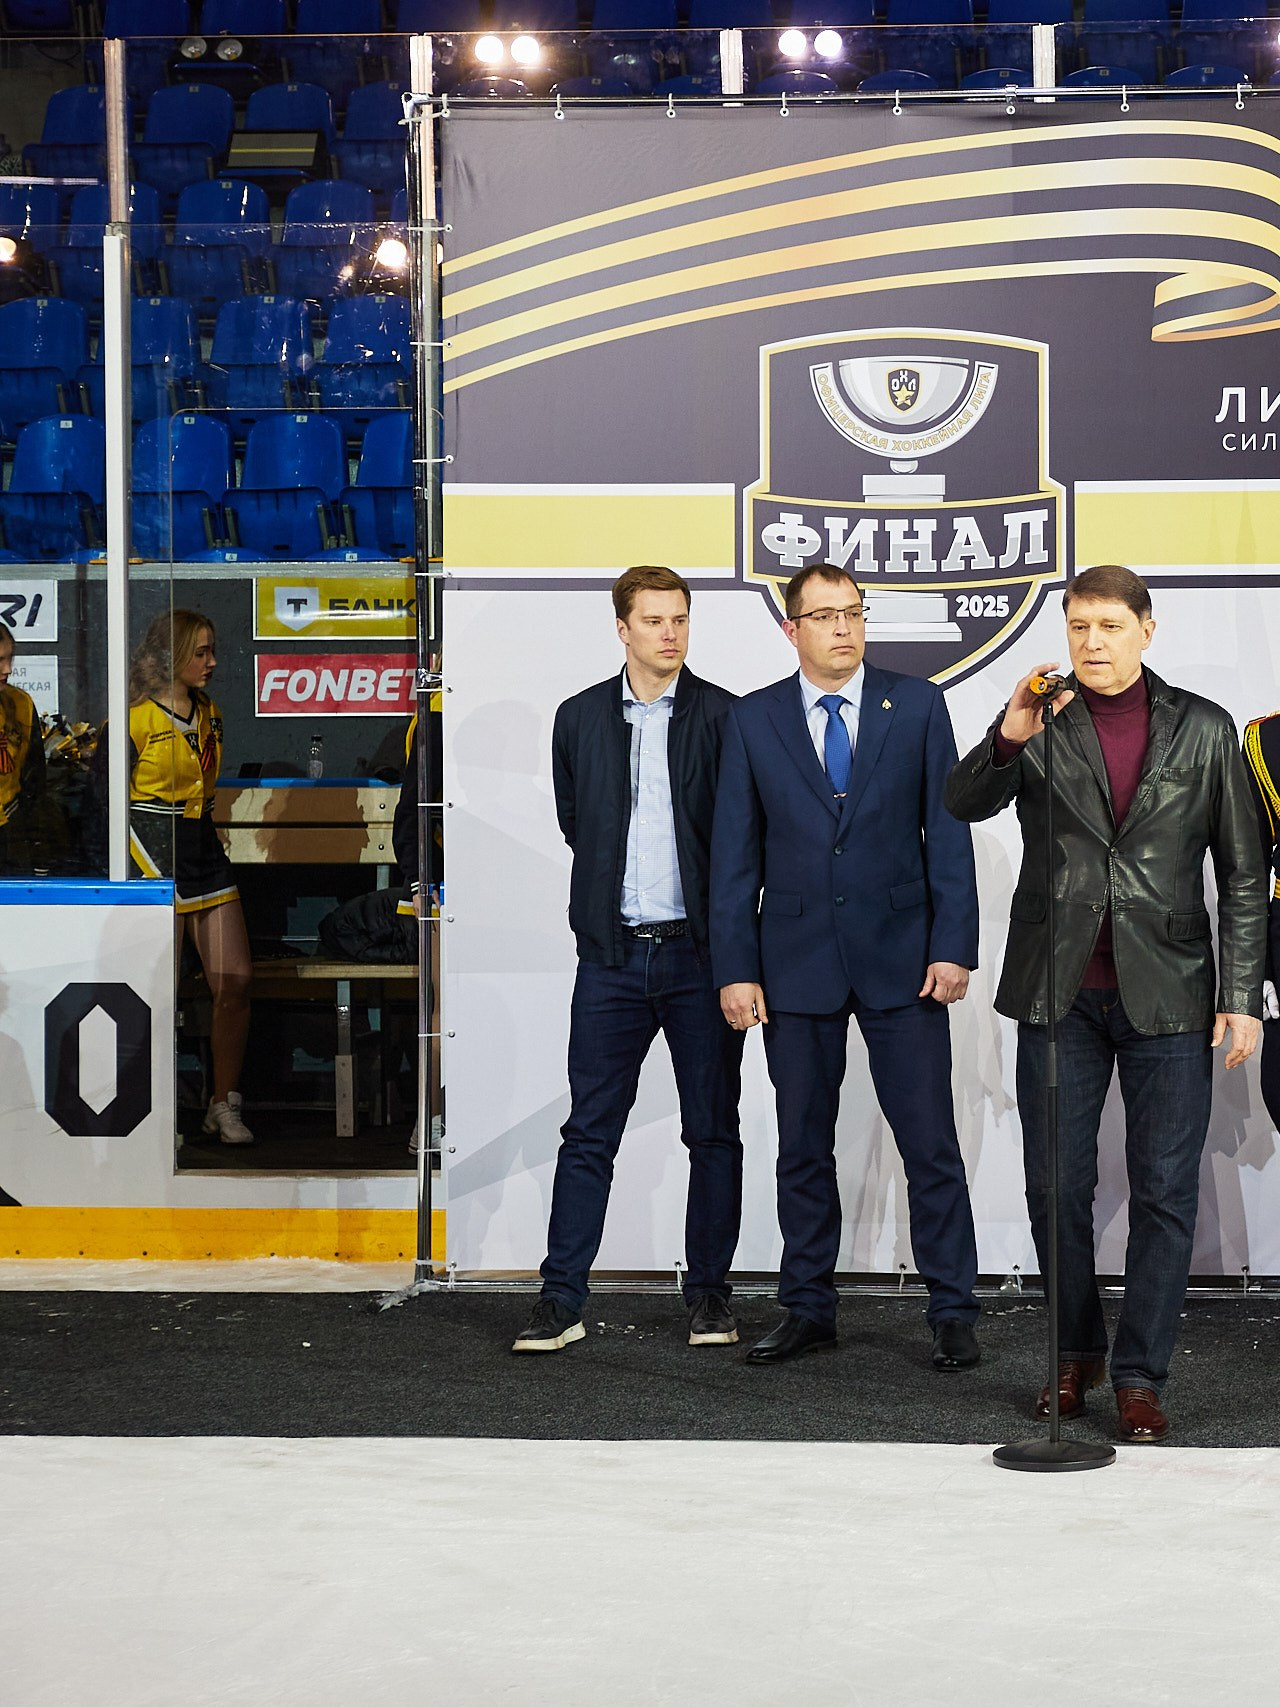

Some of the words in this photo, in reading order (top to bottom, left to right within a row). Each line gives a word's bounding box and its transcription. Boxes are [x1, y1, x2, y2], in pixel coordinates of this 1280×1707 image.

[817, 373, 889, 450] ОФИЦЕРСКАЯ
[891, 412, 974, 451] ХОККЕЙНАЯ
[972, 371, 992, 409] ЛИГА
[761, 508, 1049, 573] ФИНАЛ
[955, 595, 1011, 618] 2025
